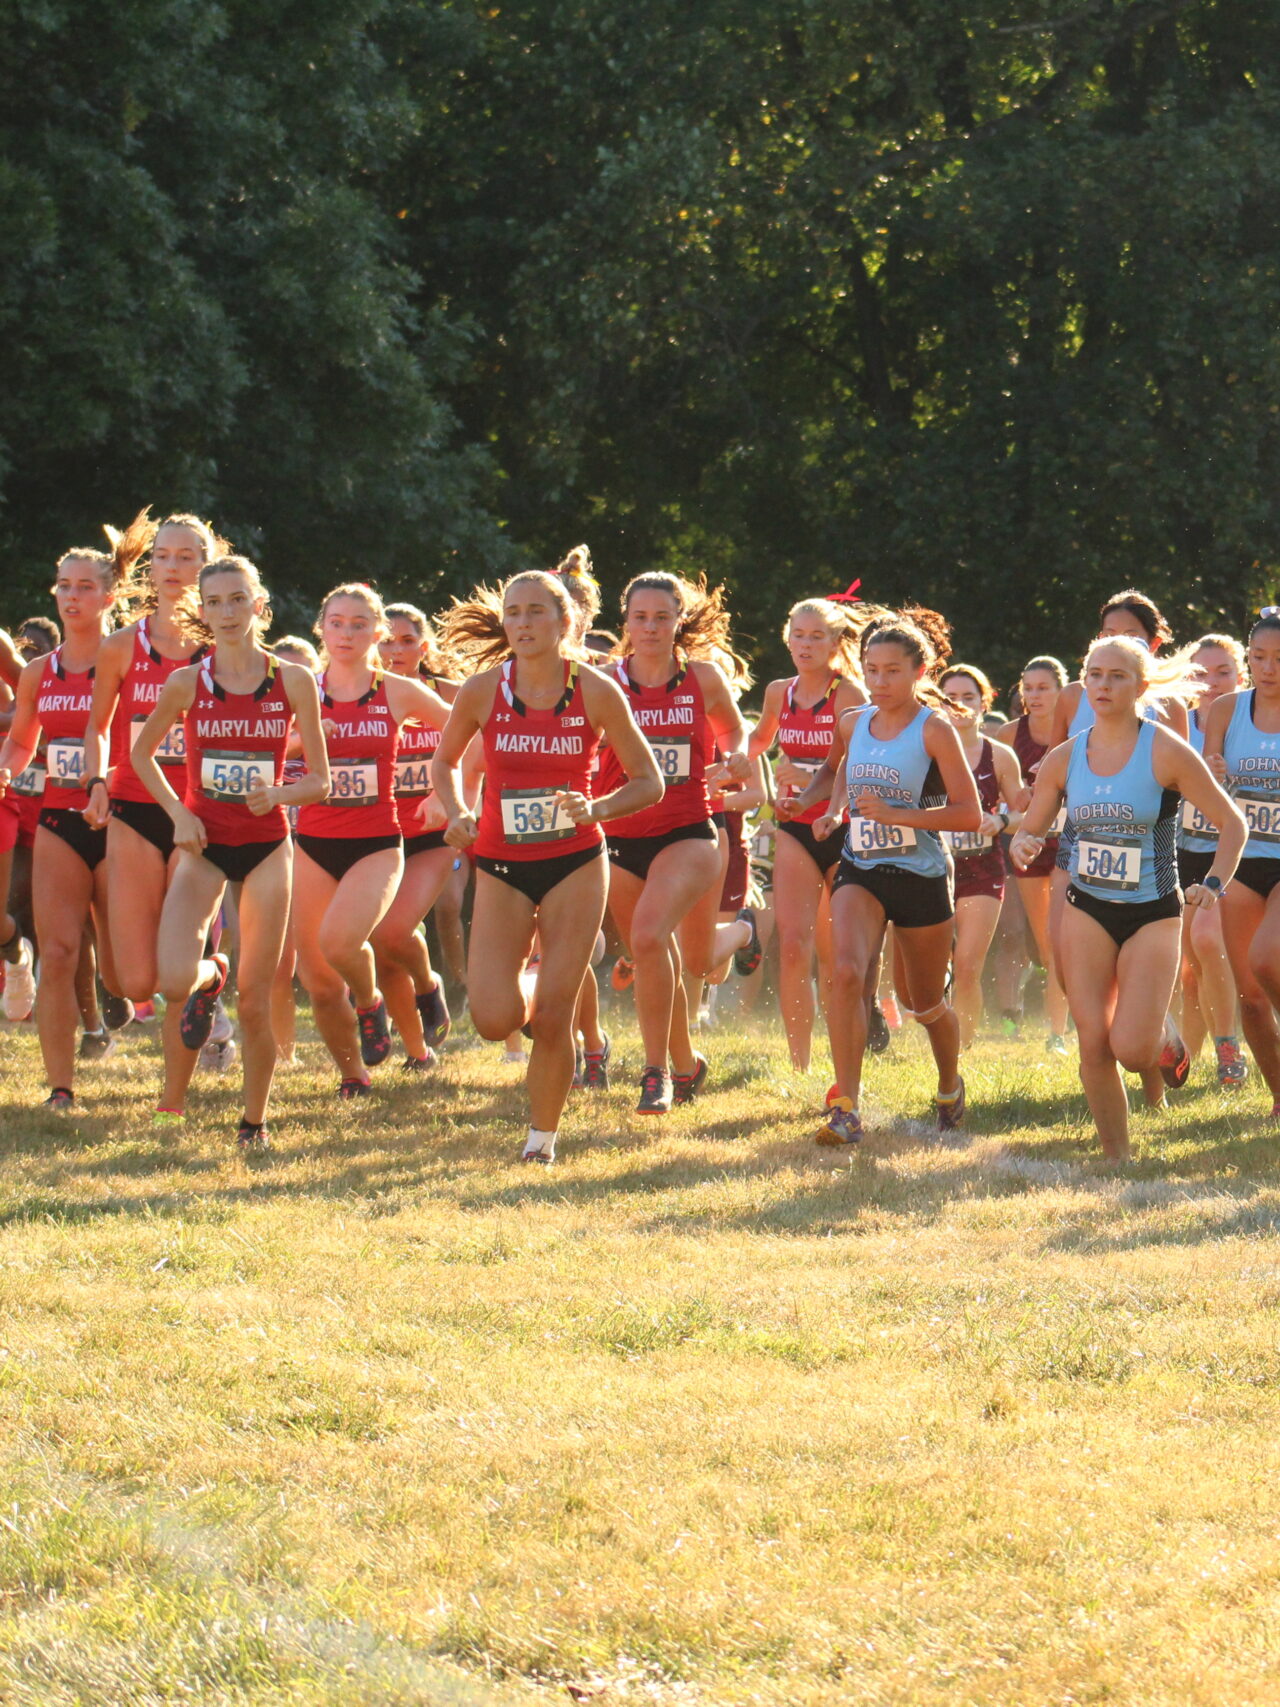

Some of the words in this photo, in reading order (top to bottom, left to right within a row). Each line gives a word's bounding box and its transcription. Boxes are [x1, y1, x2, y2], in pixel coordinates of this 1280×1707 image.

[38, 695, 93, 713] MARYLAN
[633, 707, 694, 727] ARYLAND
[197, 719, 286, 738] MARYLAND
[332, 721, 388, 739] YLAND
[158, 728, 186, 756] 43
[401, 731, 443, 749] YLAND
[495, 733, 583, 755] MARYLAND
[56, 750, 87, 778] 54
[850, 763, 900, 785] JOHNS
[213, 764, 261, 794] 536
[513, 801, 560, 833] 537
[1073, 803, 1134, 822] JOHNS
[860, 821, 904, 850] 505
[1086, 847, 1128, 881] 504
